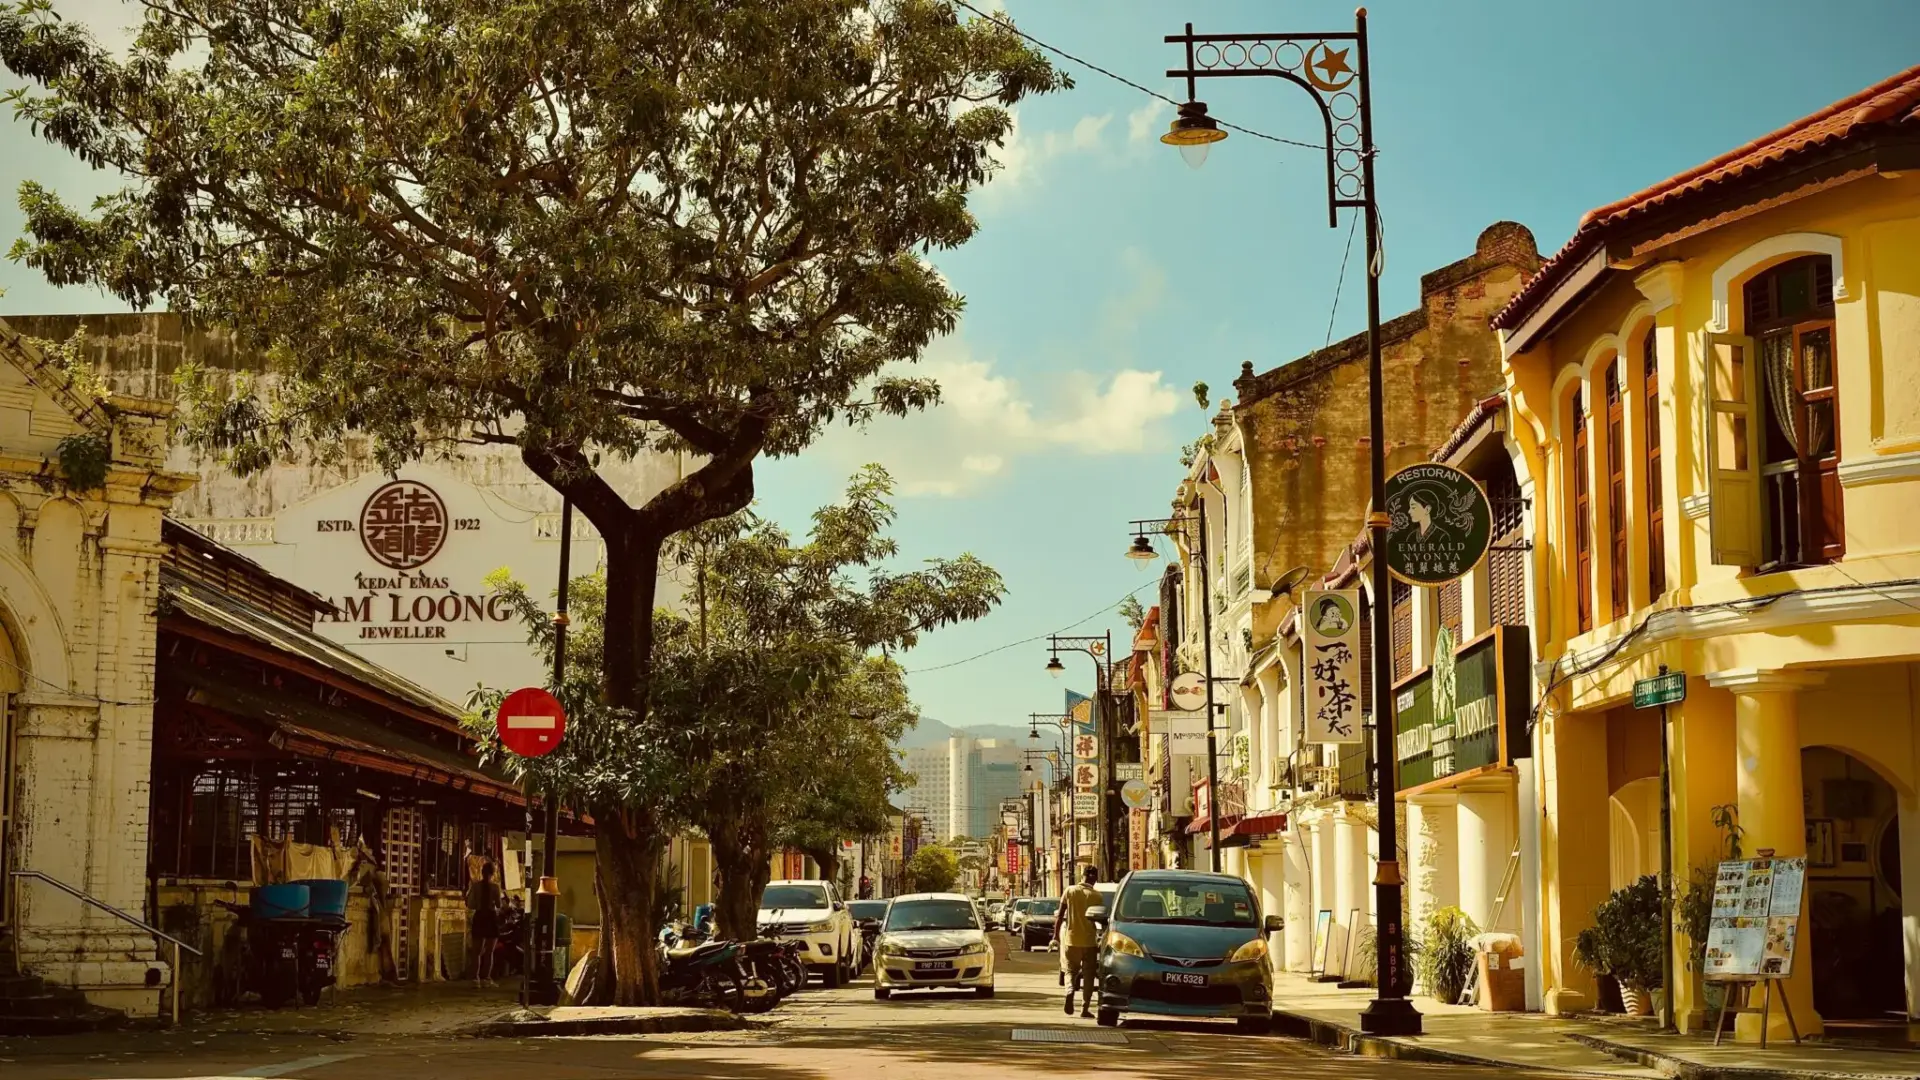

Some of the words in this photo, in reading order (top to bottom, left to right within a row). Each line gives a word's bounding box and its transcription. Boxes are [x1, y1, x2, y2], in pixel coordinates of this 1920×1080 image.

[1396, 467, 1461, 484] RESTORAN
[317, 520, 355, 532] ESTD.
[454, 519, 480, 530] 1922
[1398, 542, 1466, 552] EMERALD
[1402, 552, 1461, 561] NYONYA
[357, 577, 401, 589] KEDAI
[409, 577, 449, 589] EMAS
[389, 594, 512, 623] LOONG
[359, 626, 446, 639] JEWELLER
[1635, 682, 1653, 696] LEBUH
[1455, 697, 1494, 738] NYONYA
[1166, 973, 1182, 982] PKK
[1183, 975, 1203, 984] 5328
